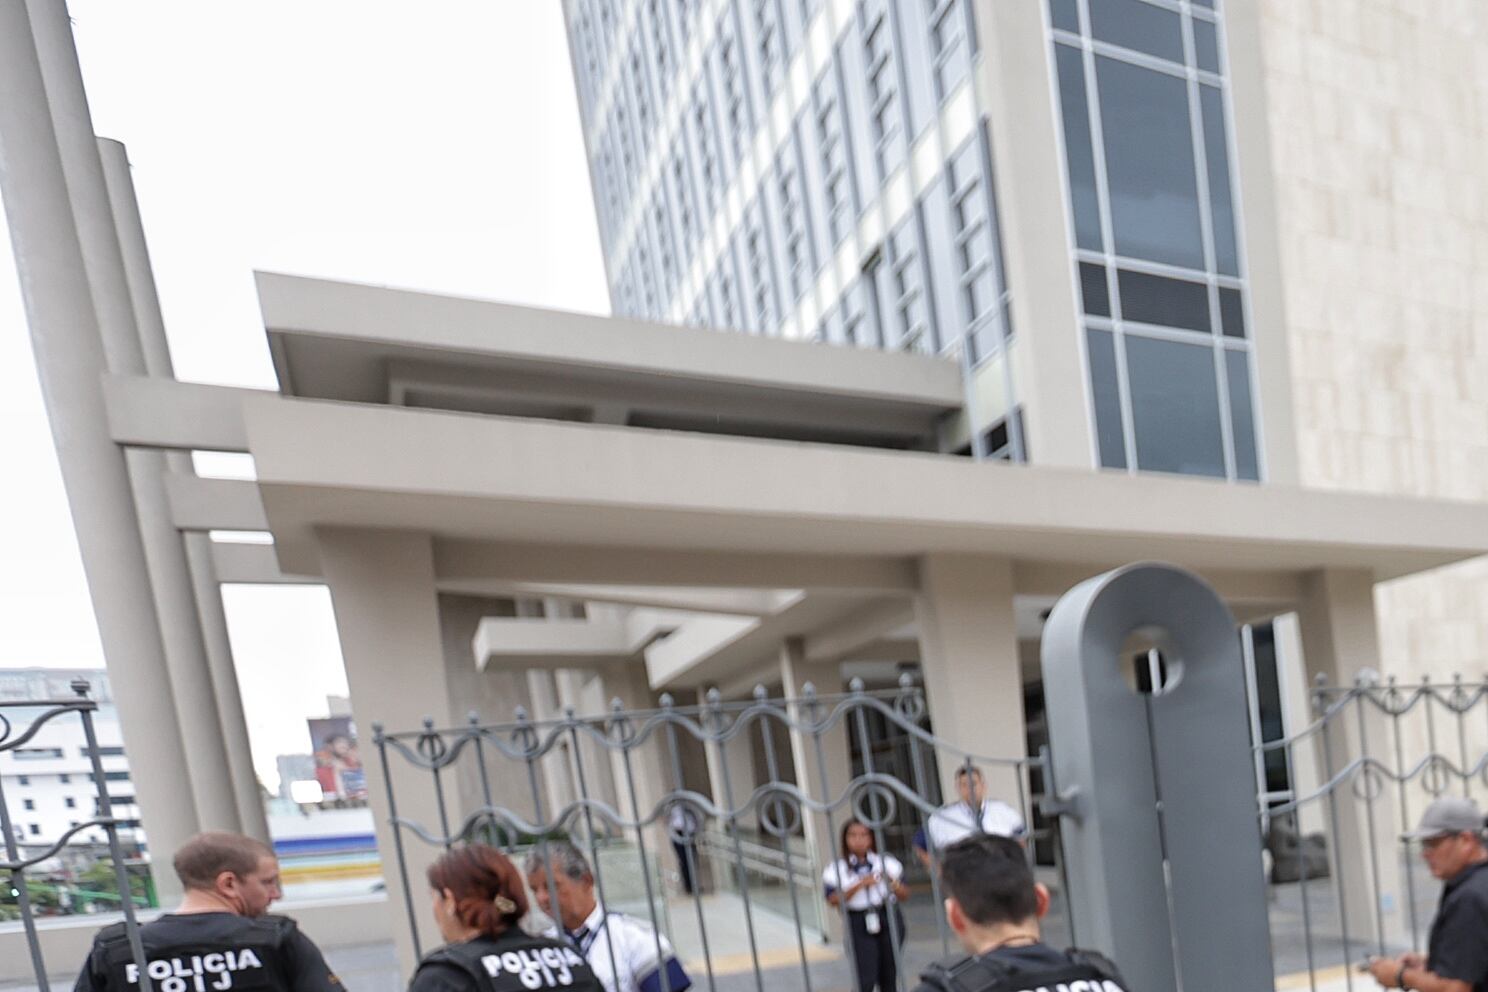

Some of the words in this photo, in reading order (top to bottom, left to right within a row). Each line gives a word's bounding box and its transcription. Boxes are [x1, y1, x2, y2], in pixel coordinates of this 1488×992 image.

[125, 948, 263, 984] POLICIA
[481, 947, 584, 978] POLICIA
[520, 964, 573, 990] OIJ
